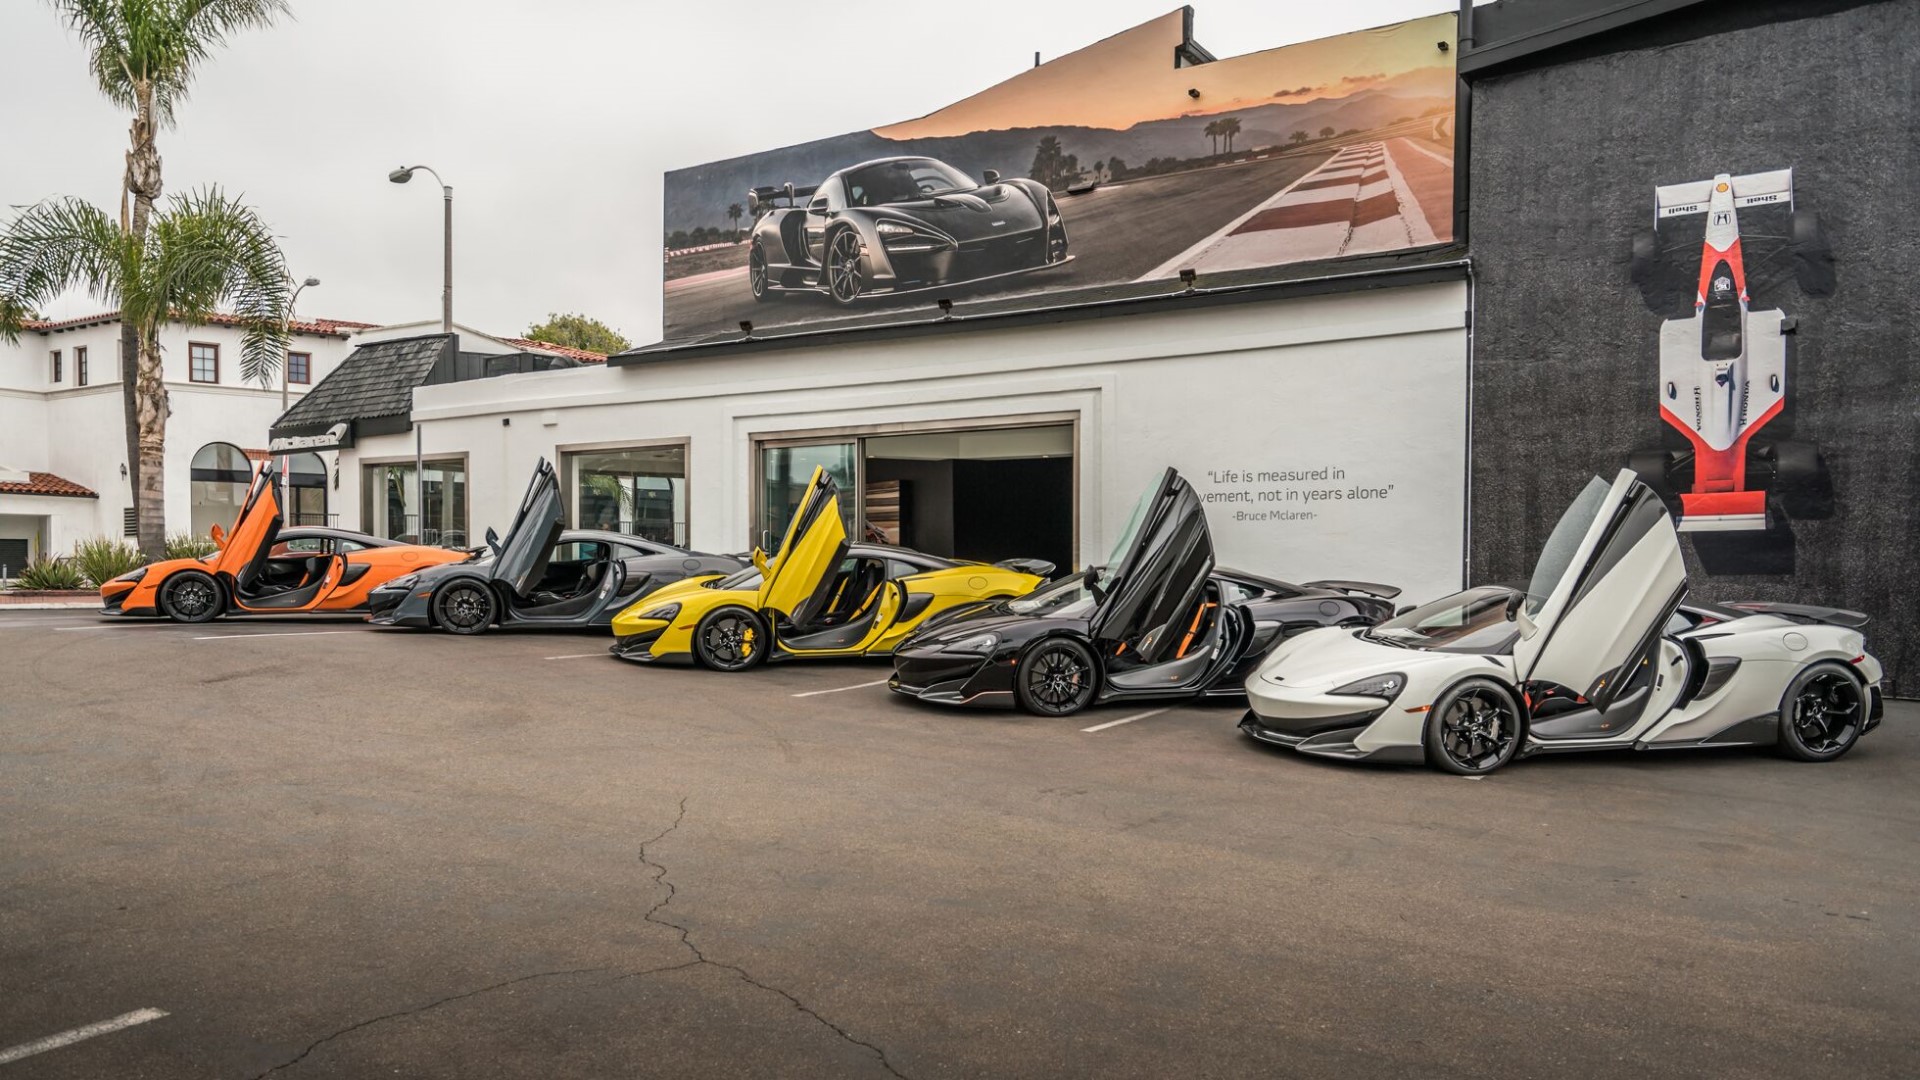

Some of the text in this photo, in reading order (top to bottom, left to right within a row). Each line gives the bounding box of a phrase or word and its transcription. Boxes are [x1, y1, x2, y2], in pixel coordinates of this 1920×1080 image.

[1746, 194, 1778, 204] Shell
[1668, 205, 1698, 215] Shell
[1208, 467, 1345, 483] “Life is measured in
[1199, 485, 1394, 504] vement, not in years alone”
[1232, 511, 1267, 521] -Bruce
